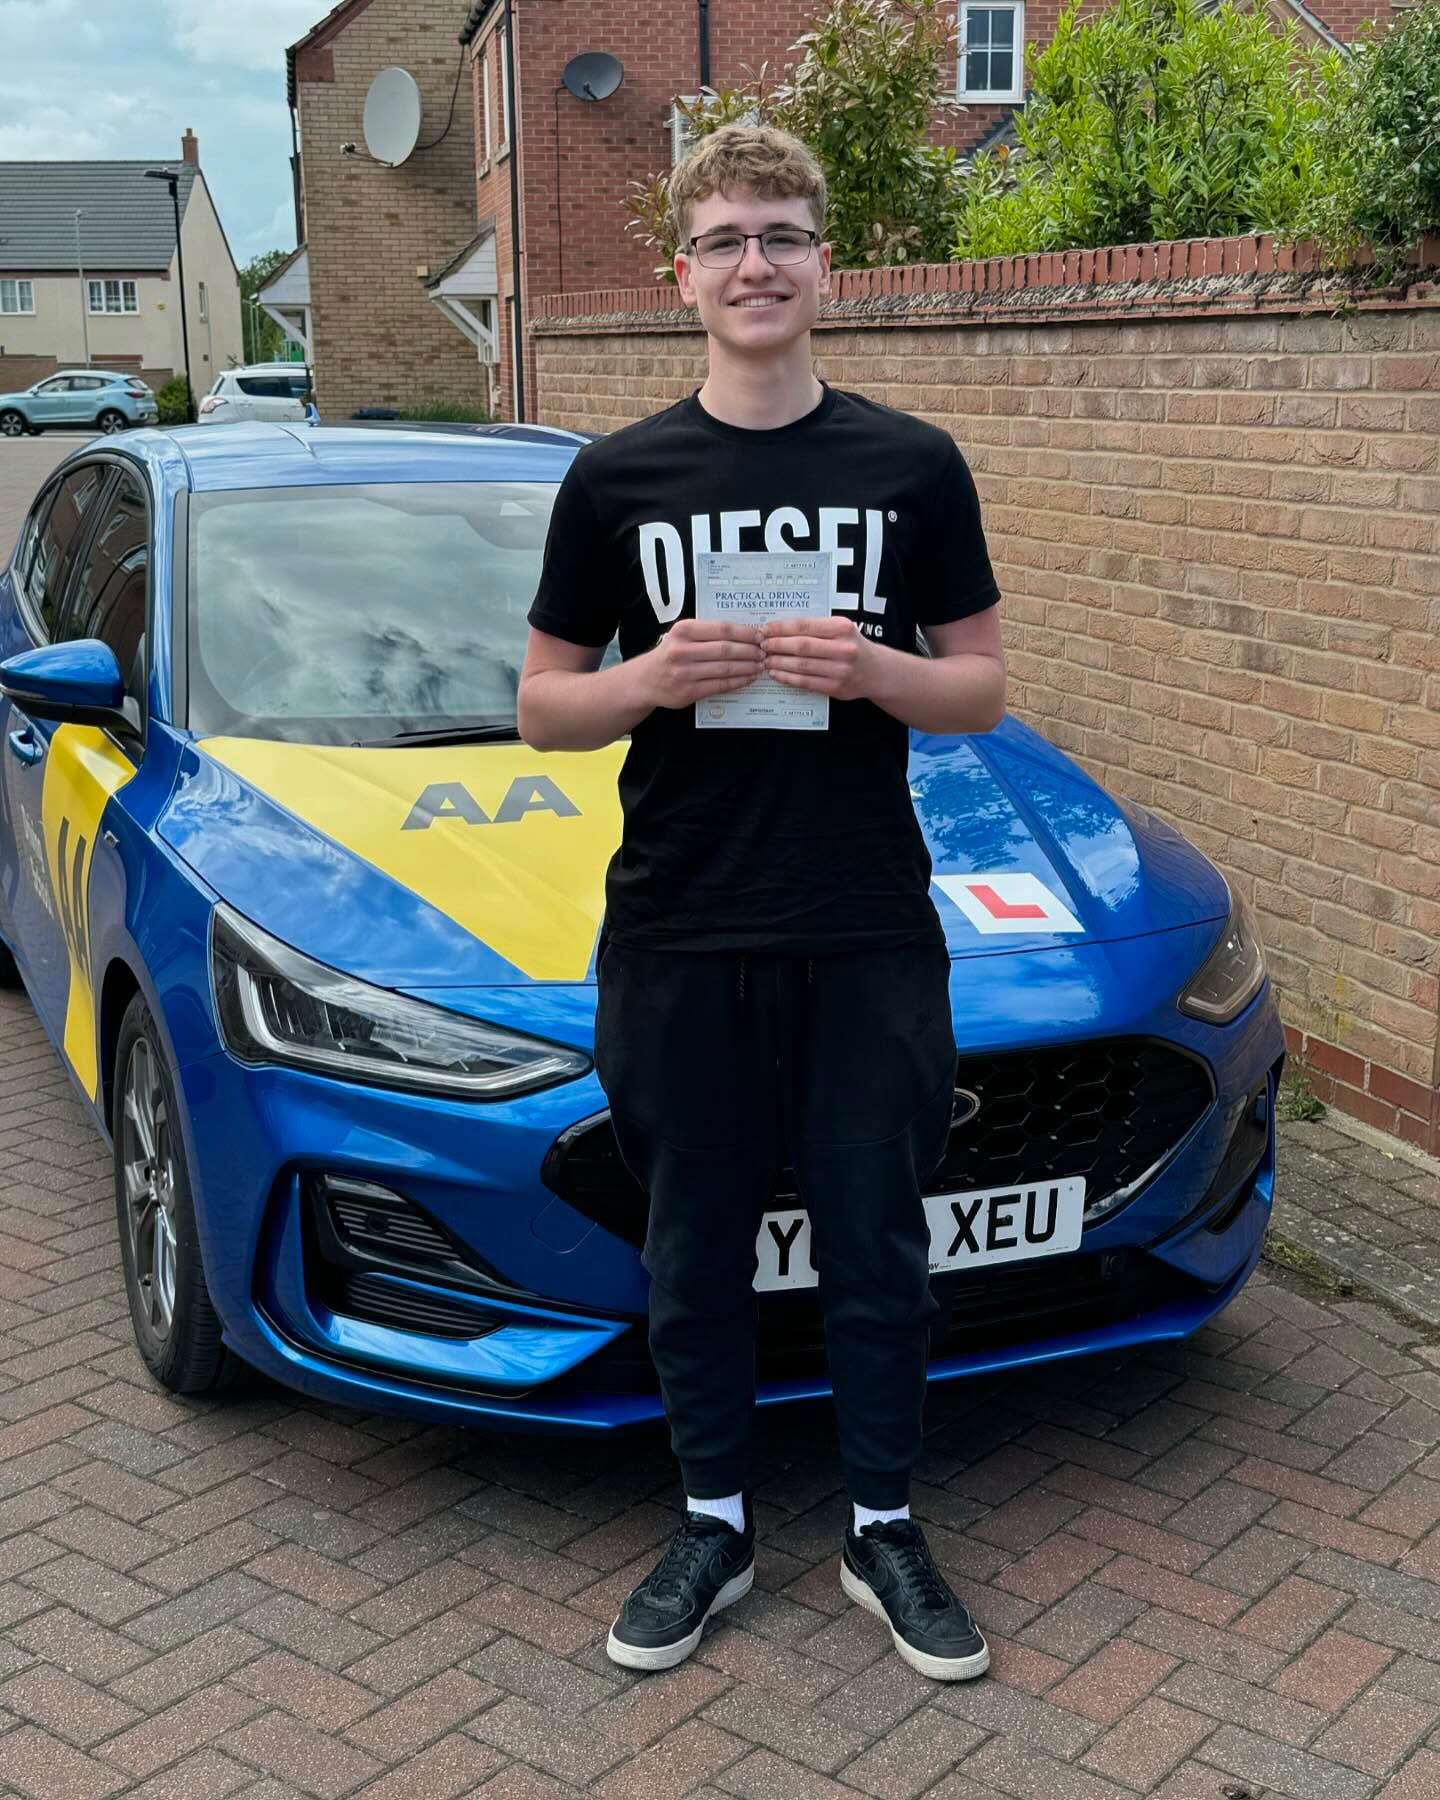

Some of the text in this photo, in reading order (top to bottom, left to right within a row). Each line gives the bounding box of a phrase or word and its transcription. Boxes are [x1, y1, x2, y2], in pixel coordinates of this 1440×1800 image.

[715, 591, 811, 601] PRACTICAL DRIVING
[716, 600, 810, 609] TEST PASS CERTIFICATE
[400, 775, 583, 830] AA
[965, 884, 1049, 919] L
[767, 1187, 1059, 1277] Y XEU
